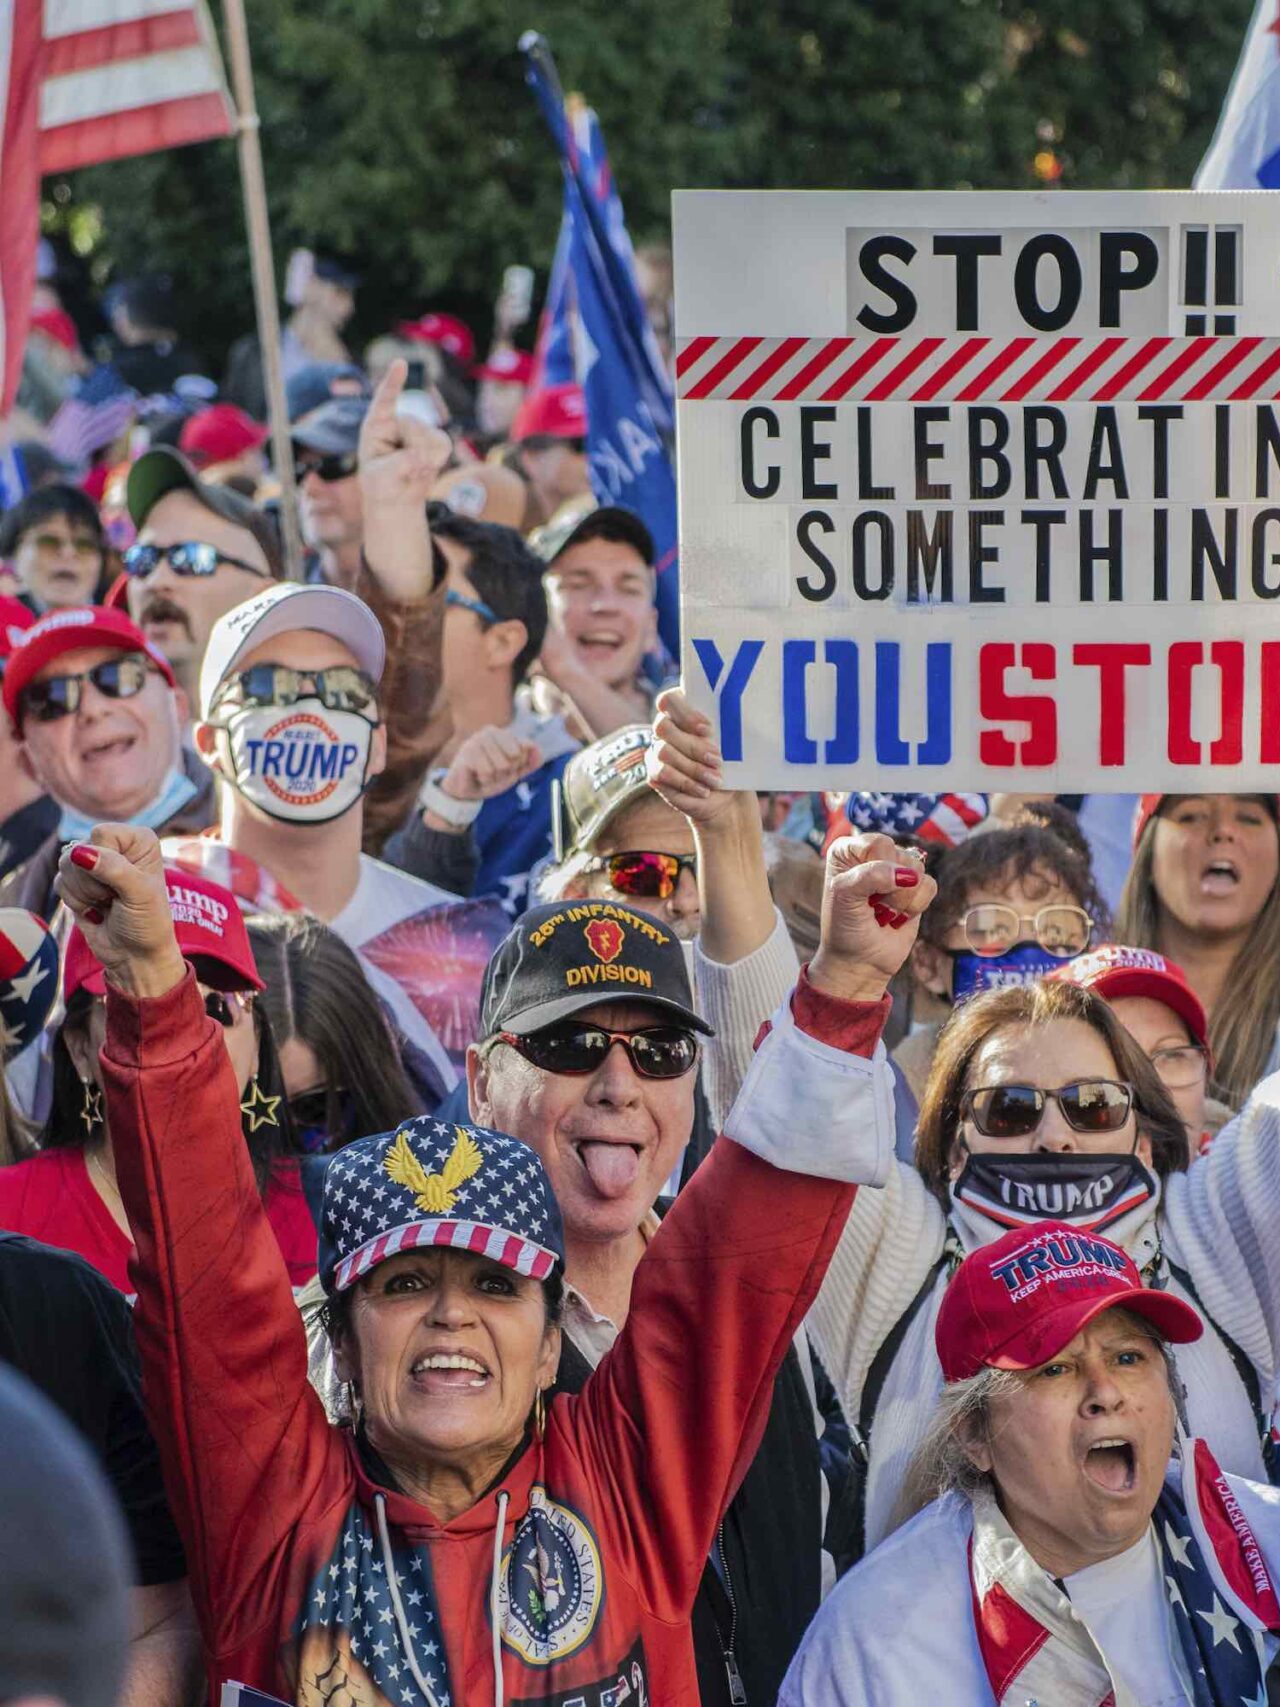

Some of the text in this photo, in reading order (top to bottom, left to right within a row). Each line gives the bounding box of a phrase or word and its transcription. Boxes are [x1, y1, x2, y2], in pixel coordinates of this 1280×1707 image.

[855, 230, 1238, 337] STOP!!
[691, 638, 954, 767] YOU
[246, 741, 359, 781] TRUMP
[166, 884, 229, 923] ump
[567, 903, 671, 946] INFANTRY
[565, 963, 653, 989] DIVISION
[999, 1174, 1114, 1214] TRUMP
[992, 1238, 1128, 1292] TRUMP
[1009, 1279, 1043, 1304] KEEP
[1043, 1265, 1101, 1285] AMERICA
[1213, 1475, 1271, 1595] MAKE AMERICA
[575, 1542, 597, 1628] STATES
